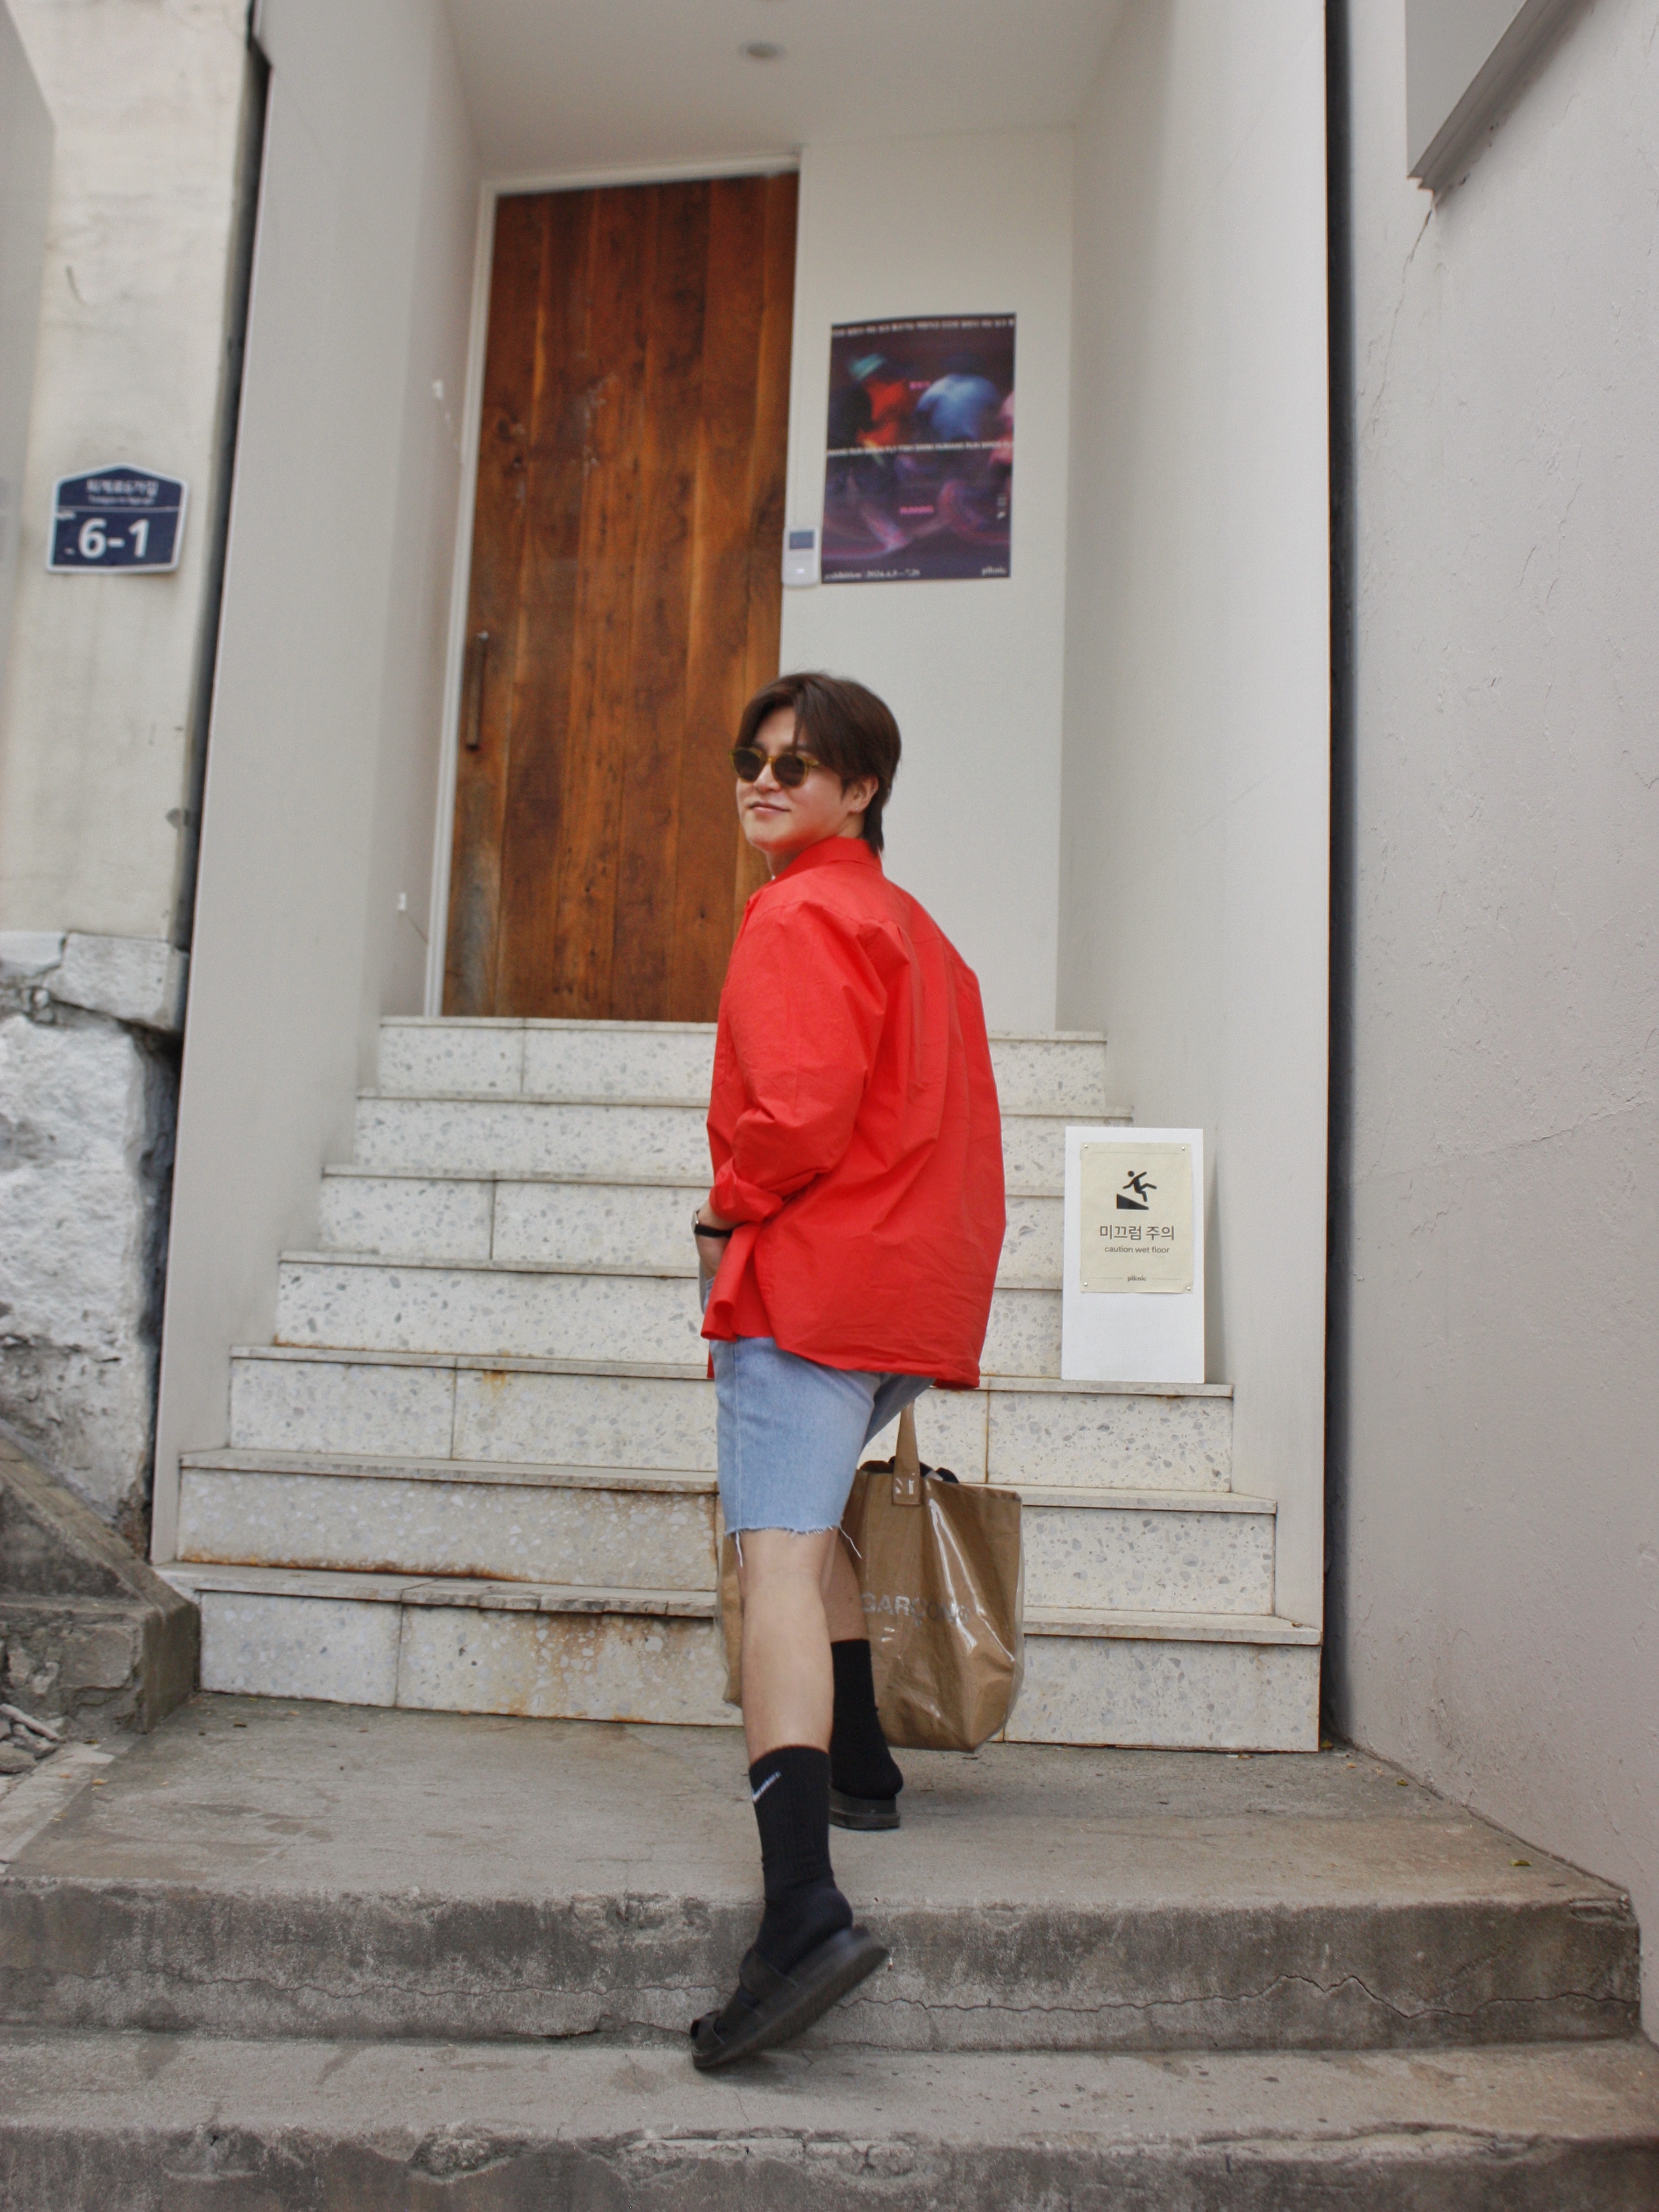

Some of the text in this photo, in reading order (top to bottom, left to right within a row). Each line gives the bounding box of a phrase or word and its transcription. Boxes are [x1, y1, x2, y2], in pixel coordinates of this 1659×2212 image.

[78, 517, 149, 559] 6-1
[1100, 1224, 1174, 1241] 미끄럼 주의
